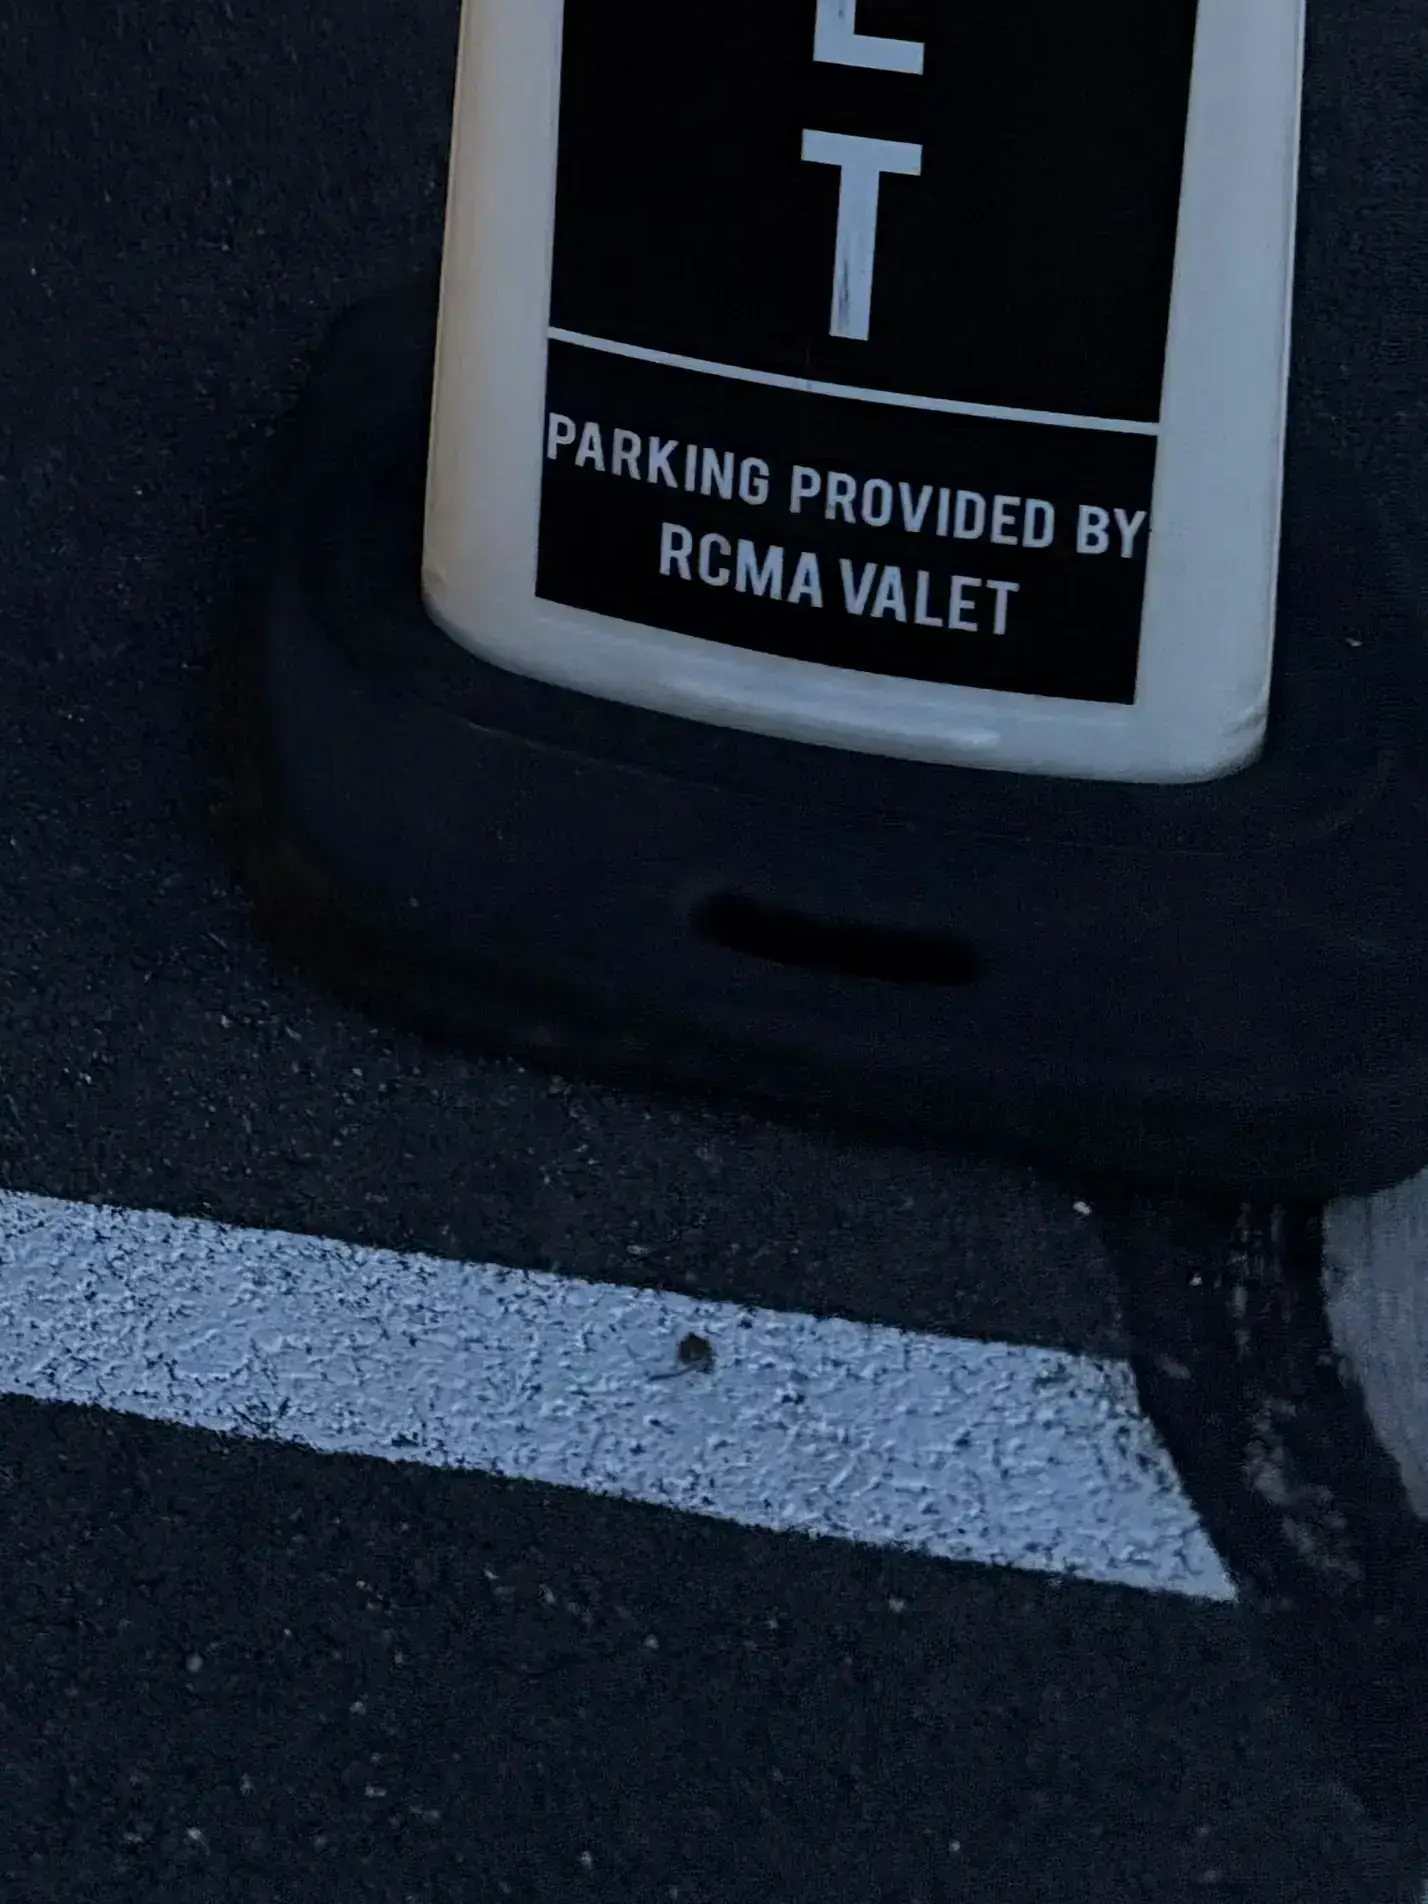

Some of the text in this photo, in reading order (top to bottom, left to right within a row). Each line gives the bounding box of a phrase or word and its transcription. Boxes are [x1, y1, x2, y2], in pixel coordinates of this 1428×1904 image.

[546, 411, 1147, 560] PARKING PROVIDED BY
[659, 522, 1021, 636] RCMA VALET
